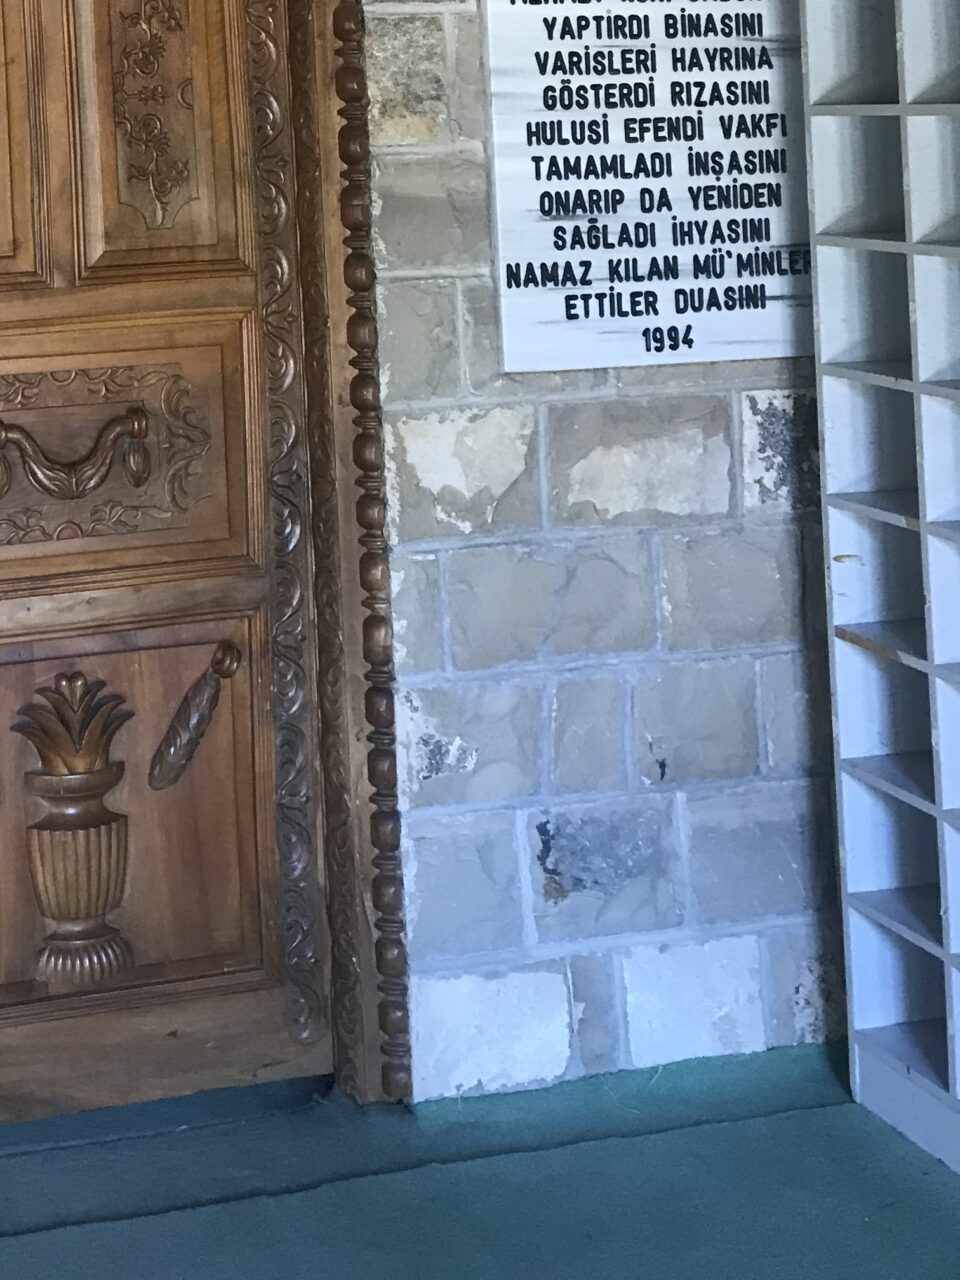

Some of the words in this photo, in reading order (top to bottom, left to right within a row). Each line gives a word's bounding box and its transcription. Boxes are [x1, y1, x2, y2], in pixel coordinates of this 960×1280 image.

[665, 8, 763, 38] BİNASINI
[535, 43, 656, 75] VARİSLERİ
[671, 45, 773, 73] HAYRINA
[543, 76, 655, 110] GÖSTERDİ
[671, 80, 770, 107] RIZASINI
[527, 113, 609, 146] HULUSİ
[624, 110, 704, 143] EFENDİ
[719, 113, 788, 139] VAKFI
[531, 152, 672, 181] TAMAMLADI
[688, 147, 787, 181] İNŞASINI
[540, 189, 625, 216] ONARIP
[640, 187, 672, 213] DA
[688, 178, 781, 210] YENİDEN
[553, 218, 655, 250] SAĞLADI
[672, 216, 770, 246] İHYASINI
[506, 261, 592, 288] NAMAZ
[608, 255, 679, 283] KILAN
[565, 286, 658, 320] ETTİLER
[674, 284, 766, 314] DUASINI
[642, 325, 694, 352] 1994
